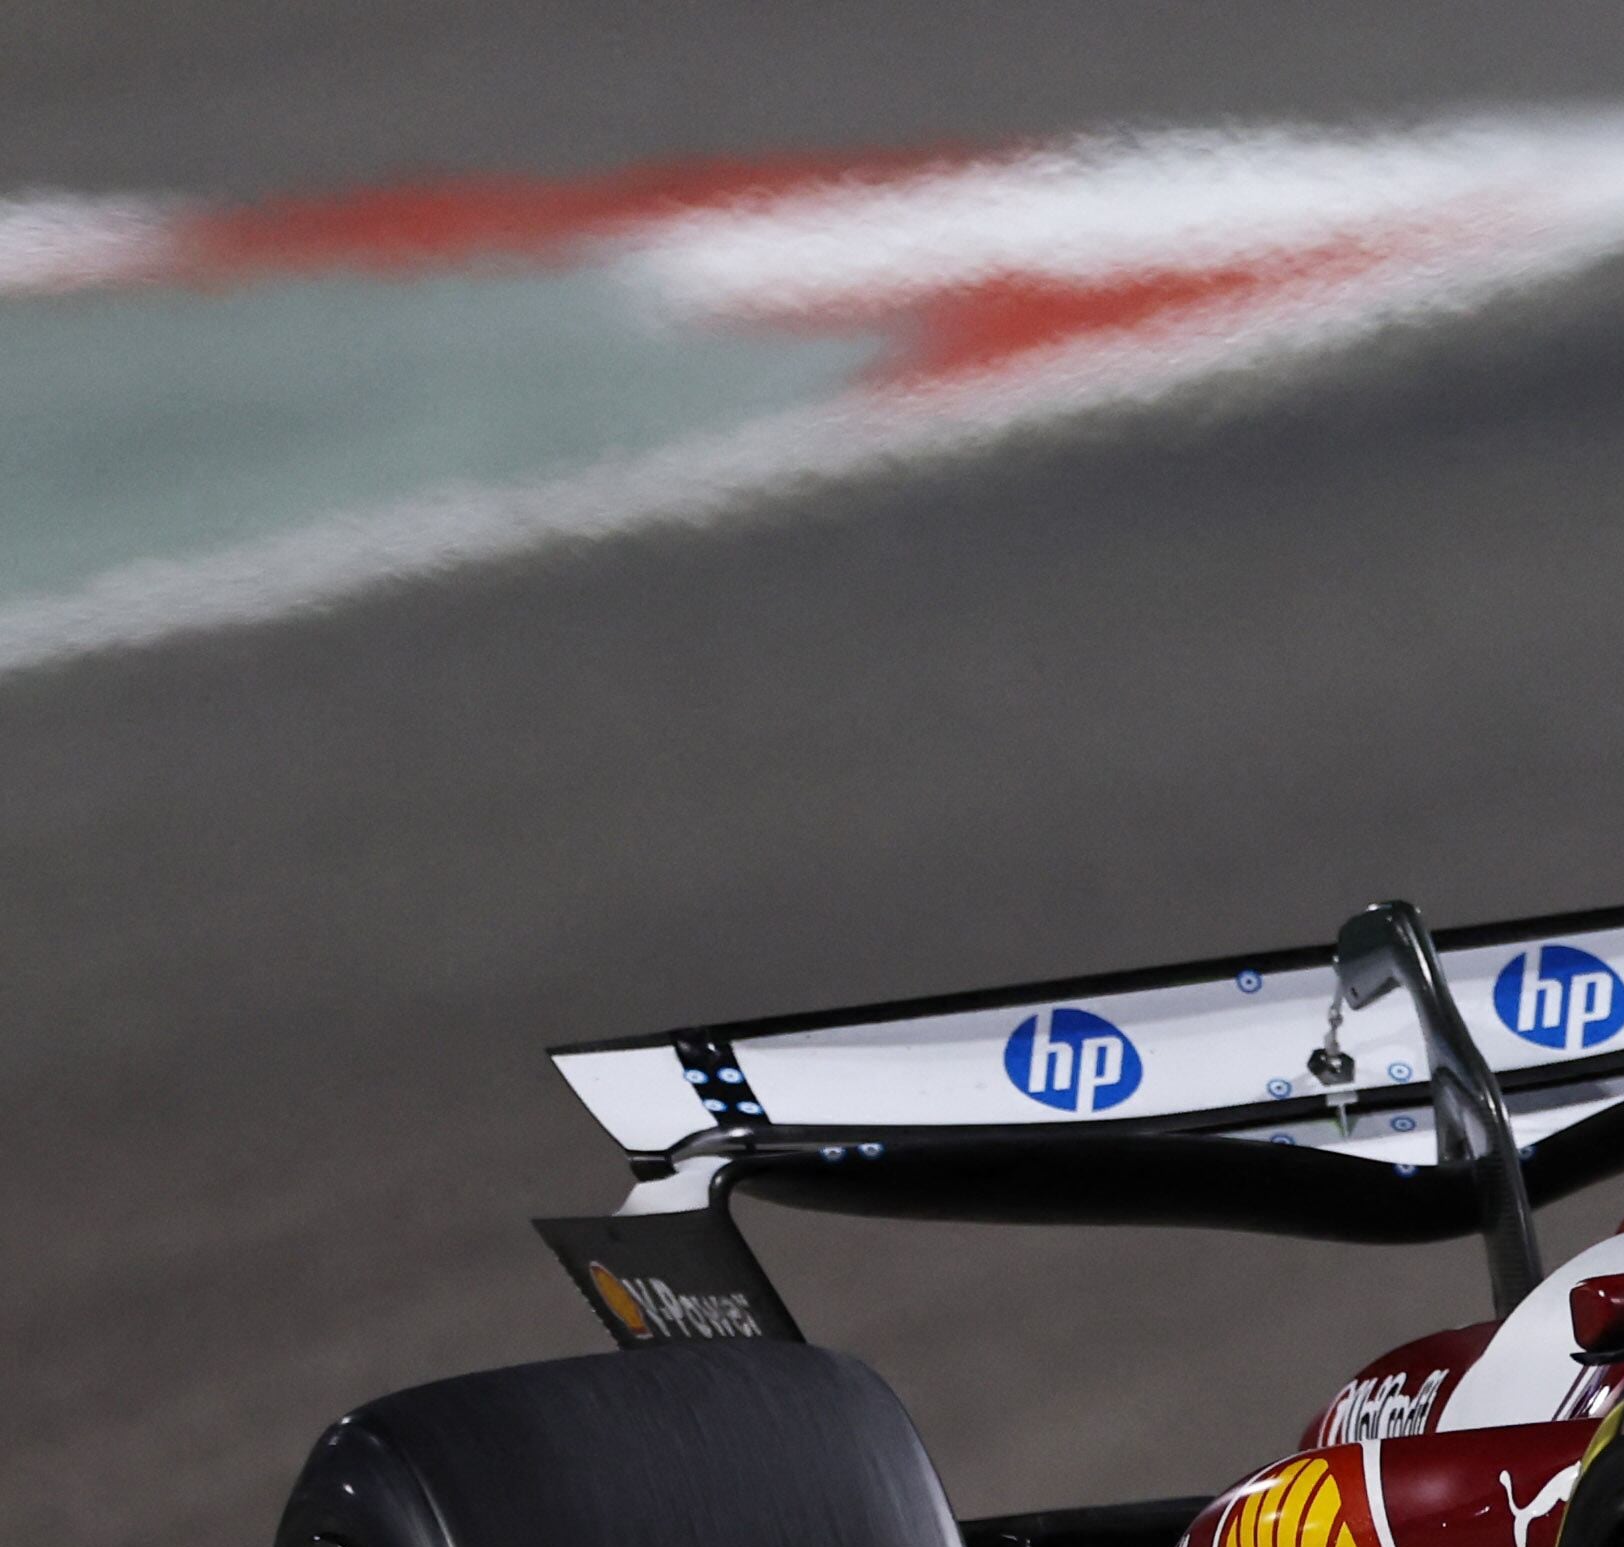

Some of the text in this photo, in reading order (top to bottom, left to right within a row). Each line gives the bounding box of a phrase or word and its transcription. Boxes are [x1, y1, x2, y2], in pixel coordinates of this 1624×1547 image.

[1516, 945, 1616, 1050] hp
[1026, 1009, 1128, 1112] hp
[621, 1277, 763, 1339] V-Power
